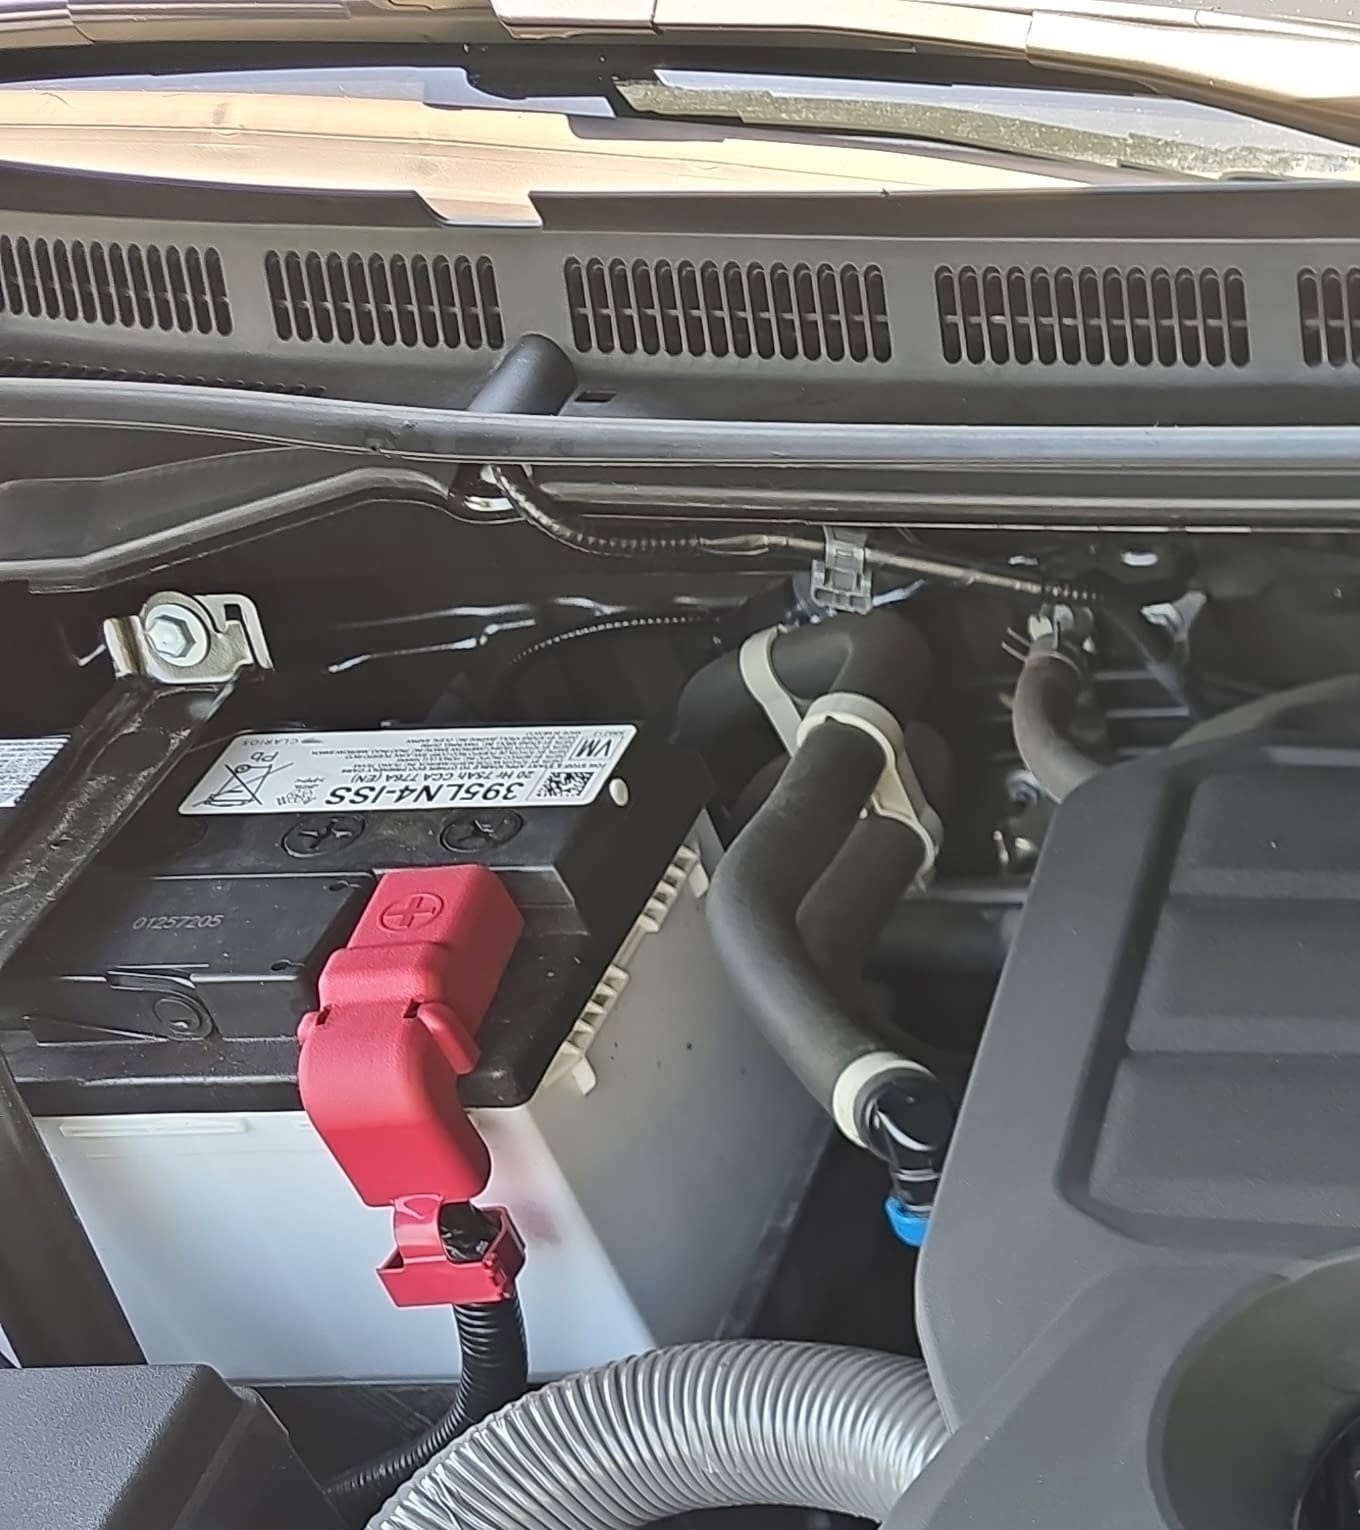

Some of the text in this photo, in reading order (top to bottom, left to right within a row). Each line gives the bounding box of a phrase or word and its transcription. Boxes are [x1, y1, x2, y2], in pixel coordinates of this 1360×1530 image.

[241, 737, 299, 746] CLARIOS
[575, 739, 613, 757] VM
[249, 751, 279, 762] Pb
[423, 772, 454, 781] CCA
[495, 770, 514, 779] Hr
[325, 782, 525, 804] 395LN4-ISS
[132, 914, 224, 930] 01257205
